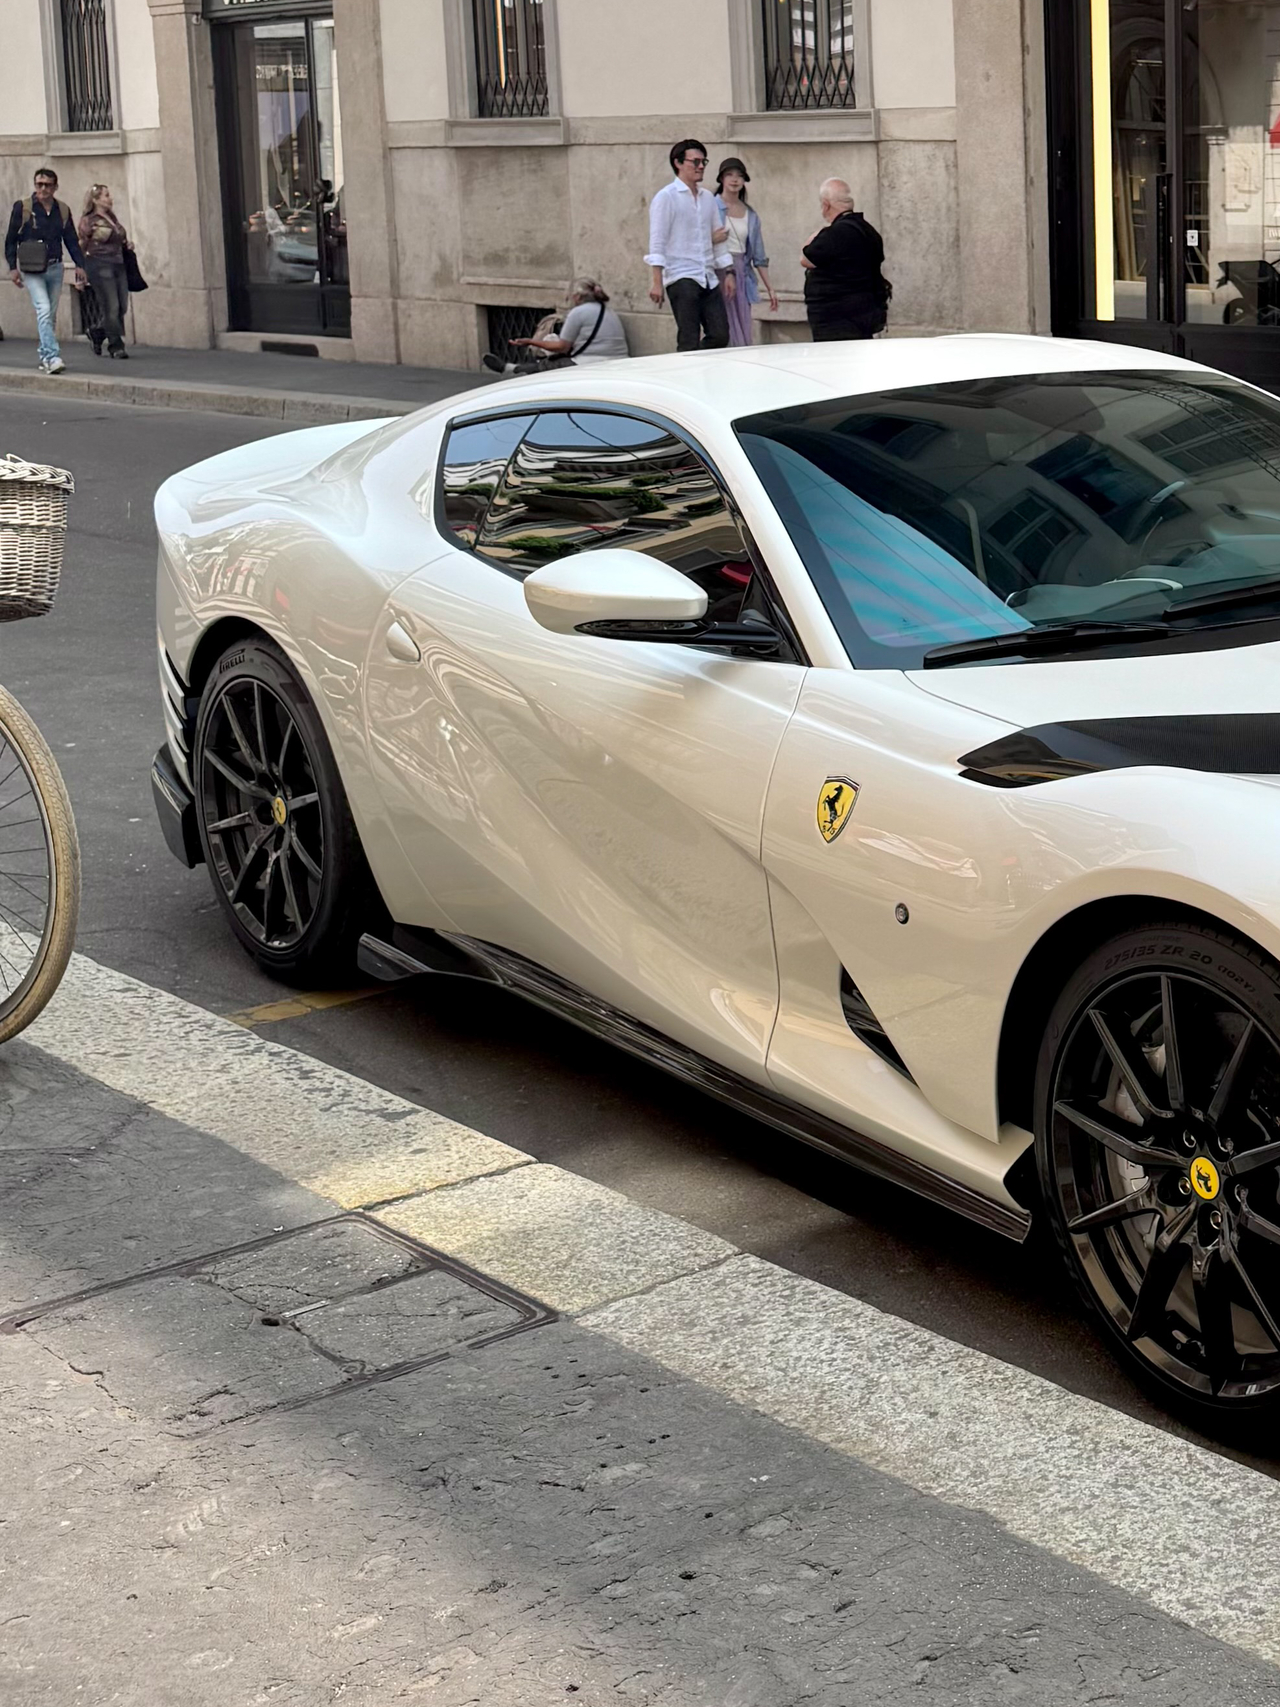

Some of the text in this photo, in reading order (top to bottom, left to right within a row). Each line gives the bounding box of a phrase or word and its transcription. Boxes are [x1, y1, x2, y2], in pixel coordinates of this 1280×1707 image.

[1104, 945, 1157, 971] 275/35
[1160, 944, 1184, 957] ZR
[1188, 951, 1213, 965] 20
